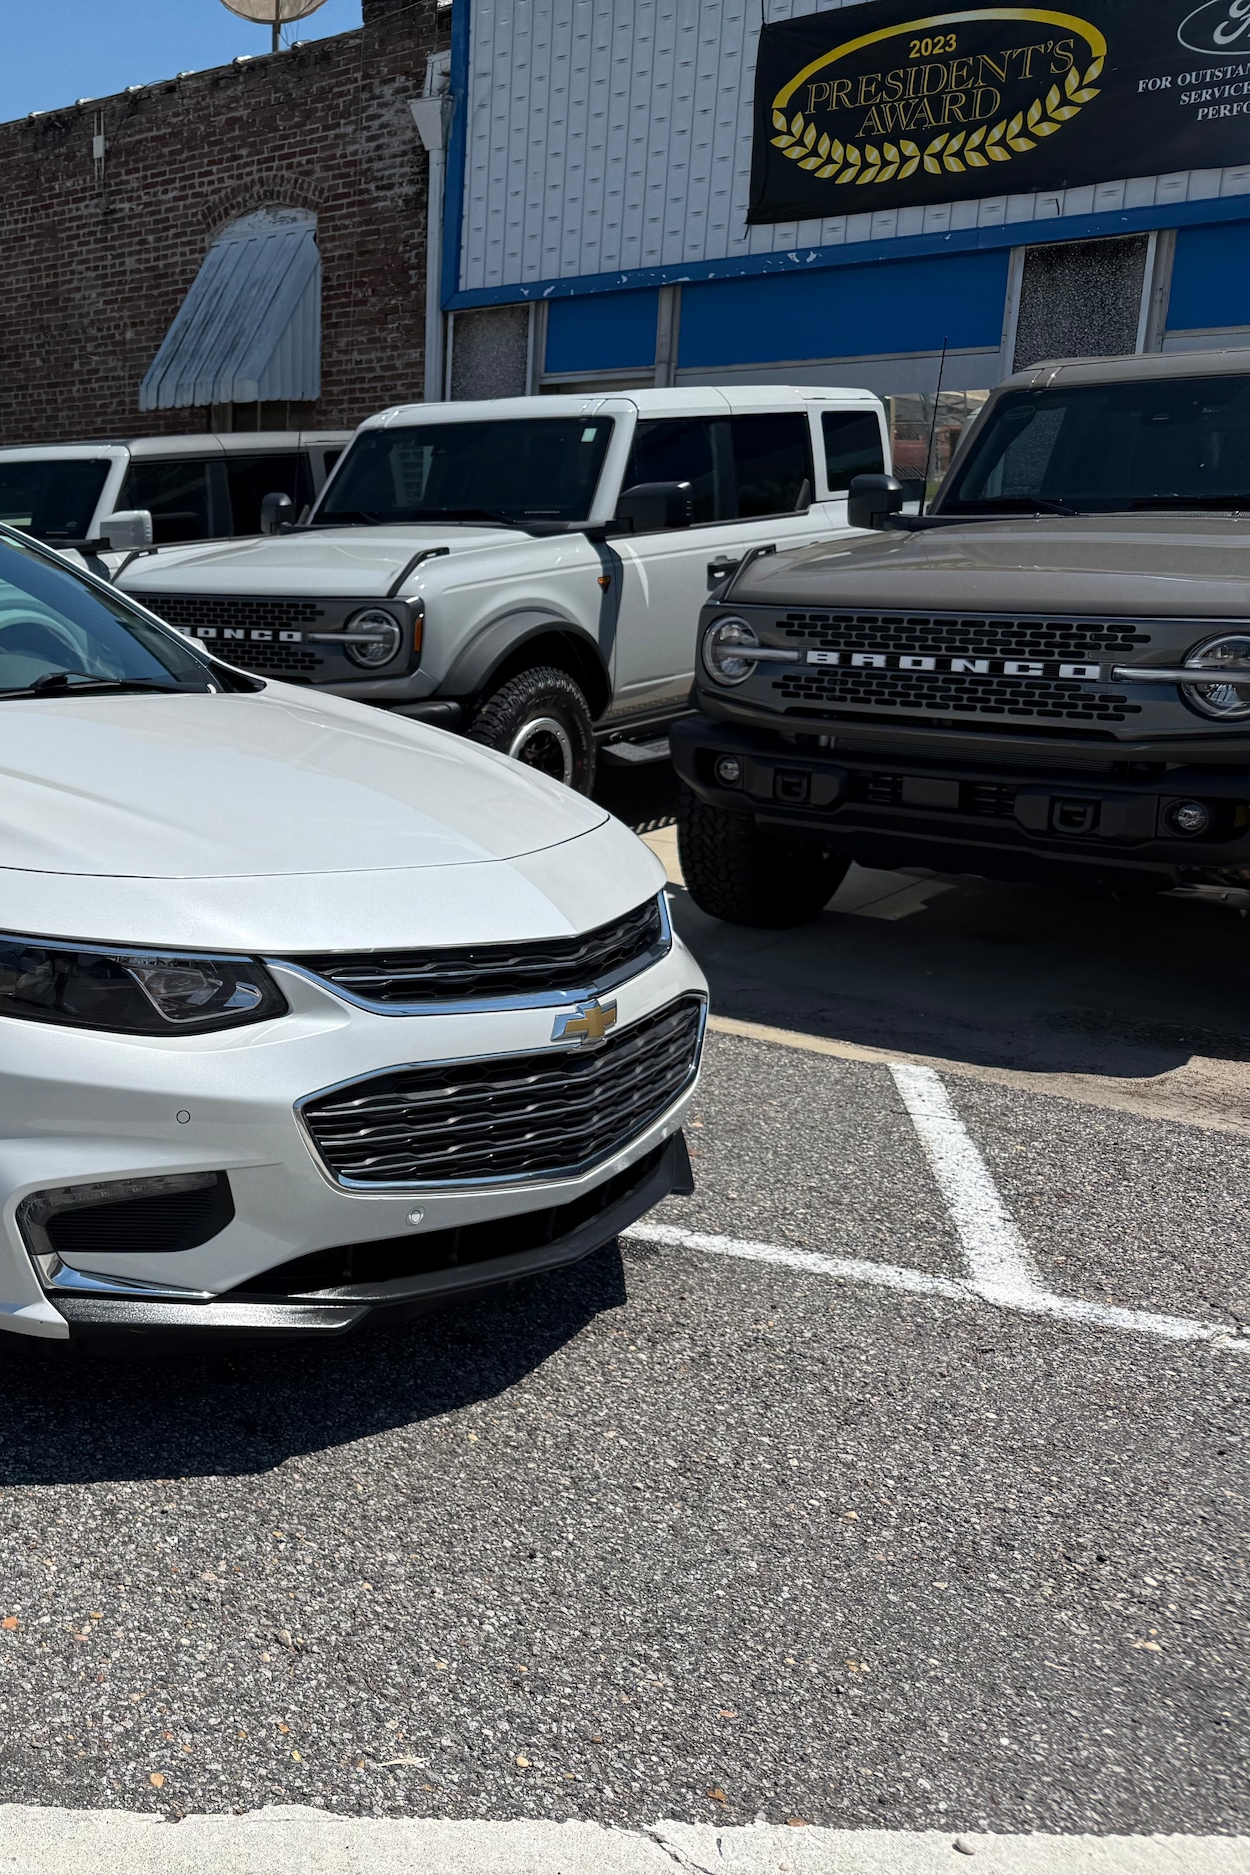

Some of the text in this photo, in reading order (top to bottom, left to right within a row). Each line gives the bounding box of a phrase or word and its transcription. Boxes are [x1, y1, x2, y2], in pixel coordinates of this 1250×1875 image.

[908, 33, 958, 59] 2023
[804, 38, 1075, 115] PRESIDENT'S
[1136, 75, 1172, 93] FOR
[855, 86, 1001, 138] AWARD
[171, 626, 302, 642] RONCO
[806, 650, 1100, 680] BRONCO
